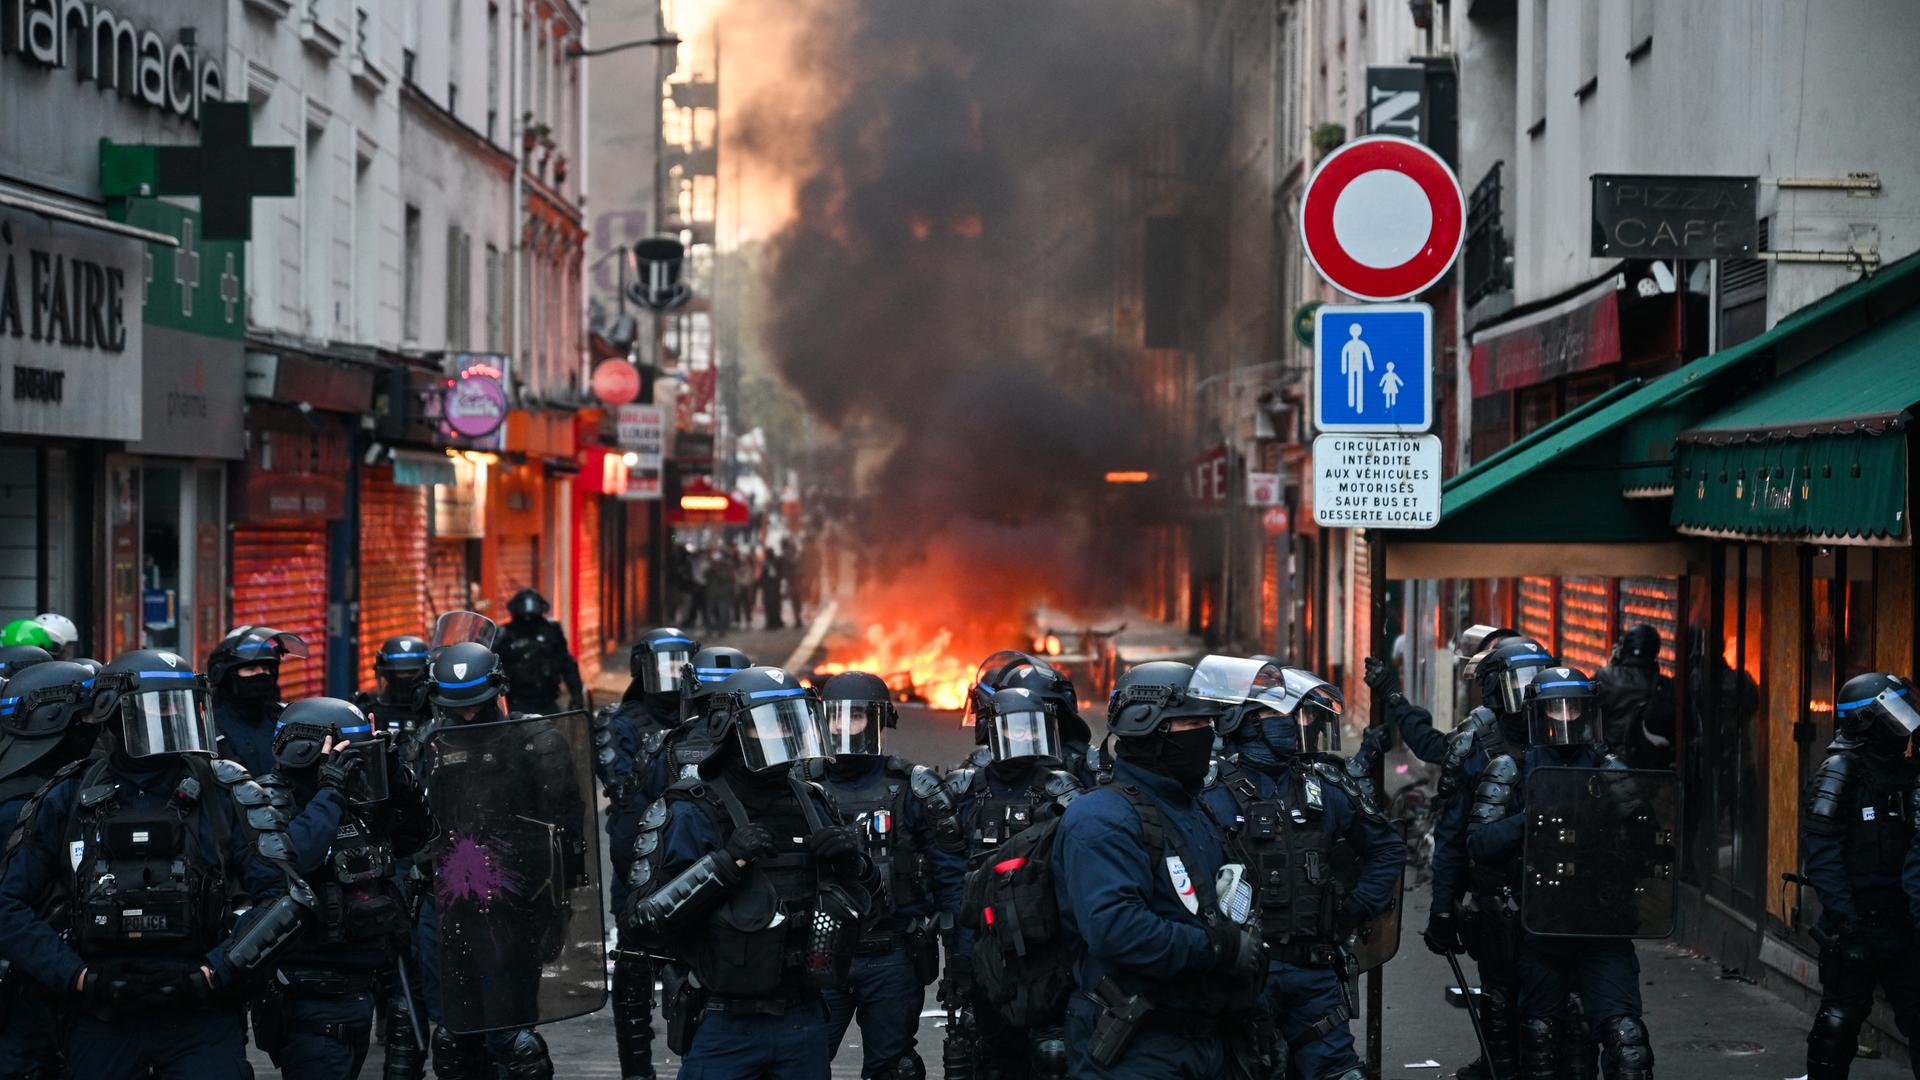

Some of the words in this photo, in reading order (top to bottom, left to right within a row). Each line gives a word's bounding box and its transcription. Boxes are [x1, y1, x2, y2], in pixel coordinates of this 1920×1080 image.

[1615, 183, 1738, 210] PIZZA
[0, 220, 24, 338] À
[30, 249, 126, 353] FAIRE
[1334, 441, 1420, 452] CIRCULATION
[1343, 455, 1411, 465] INTERDITE
[1325, 468, 1350, 479] AUX
[1356, 467, 1429, 480] VÉHICULES
[1339, 481, 1415, 493] MOTORISÉS
[1335, 496, 1368, 506] SAUF
[1374, 497, 1398, 507] BUS
[1403, 498, 1418, 507] ET
[1320, 510, 1383, 520] DESSERTE
[1387, 511, 1433, 522] LOCALE
[125, 916, 166, 929] POLICE
